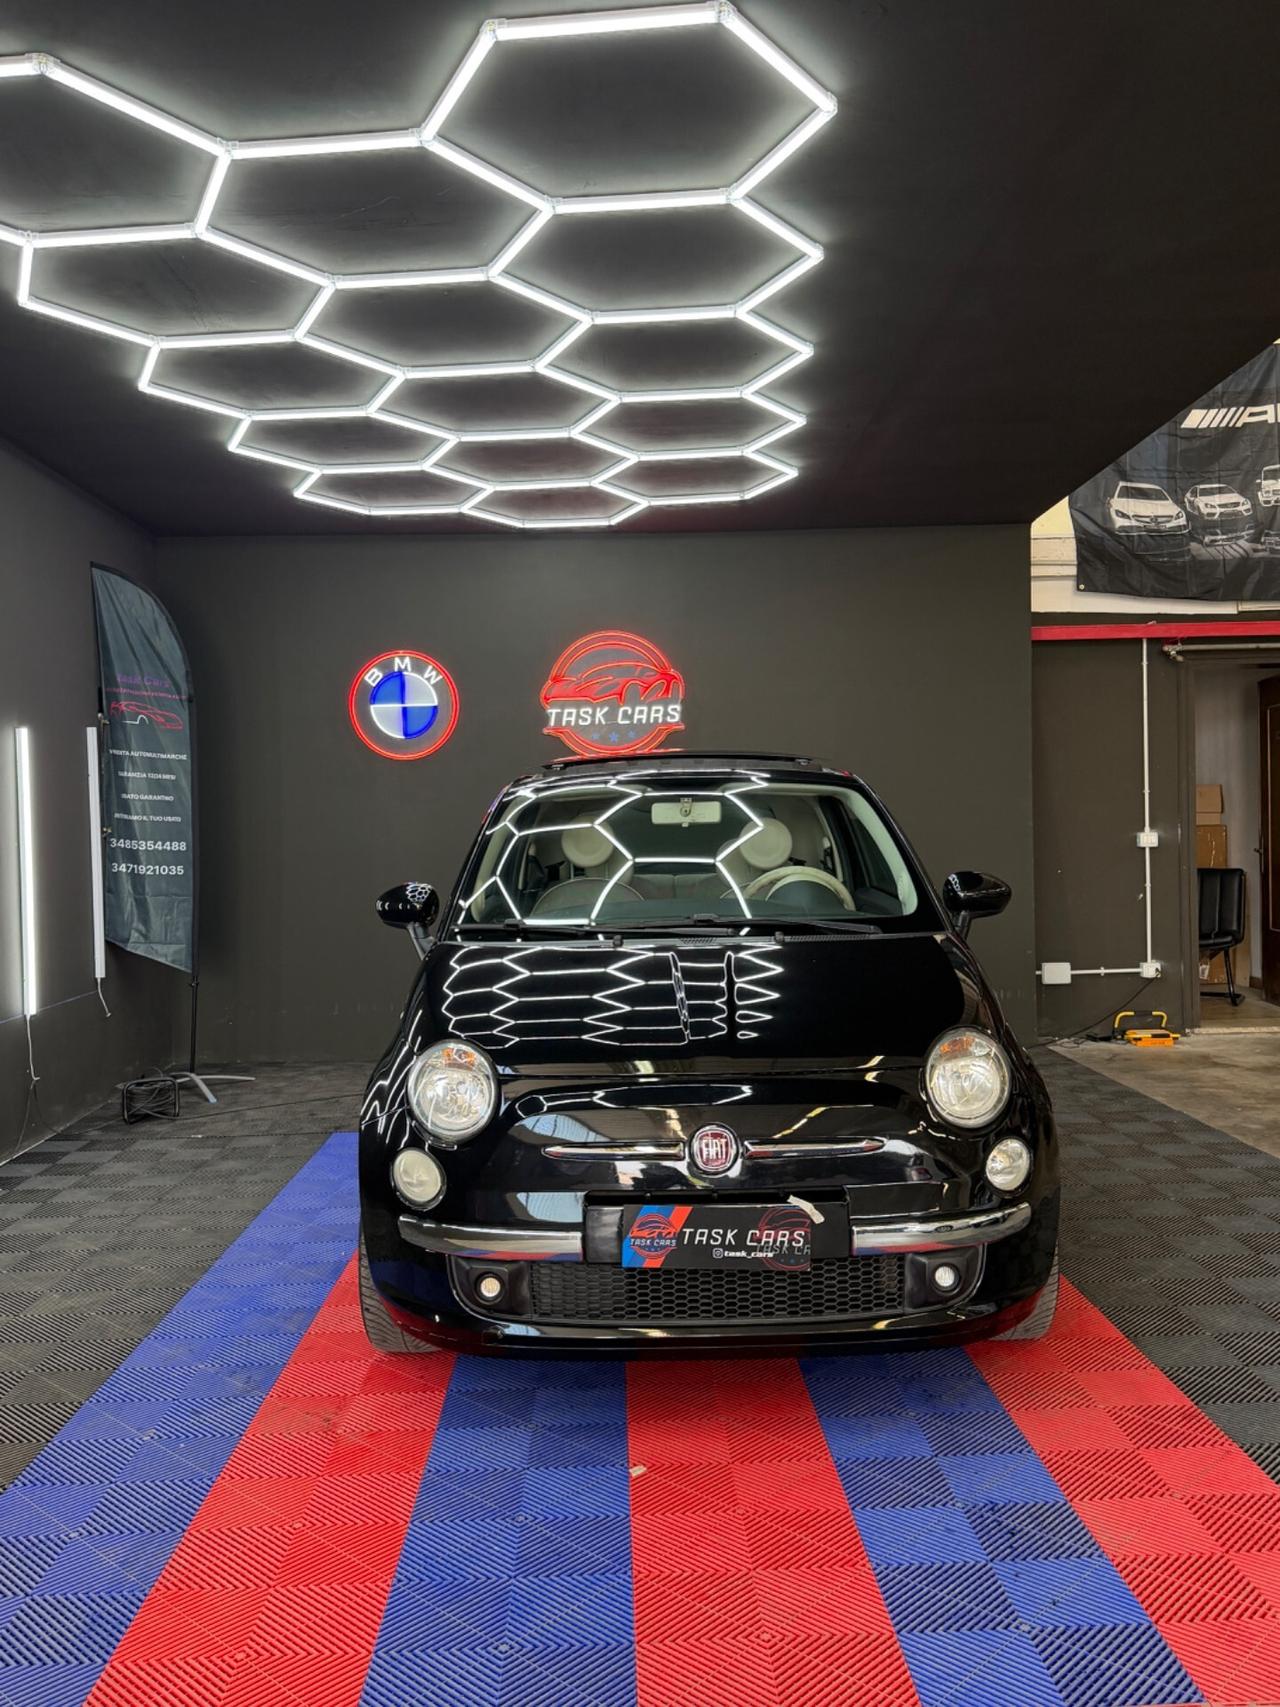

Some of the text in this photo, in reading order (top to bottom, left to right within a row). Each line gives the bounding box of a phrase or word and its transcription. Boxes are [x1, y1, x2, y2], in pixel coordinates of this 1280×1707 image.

[364, 656, 443, 687] BMW
[547, 704, 682, 727] TASK CARS
[110, 838, 187, 851] 3485354488
[111, 863, 185, 875] 3471921035
[702, 1138, 728, 1160] FIAT
[682, 1228, 806, 1247] TASK CARS
